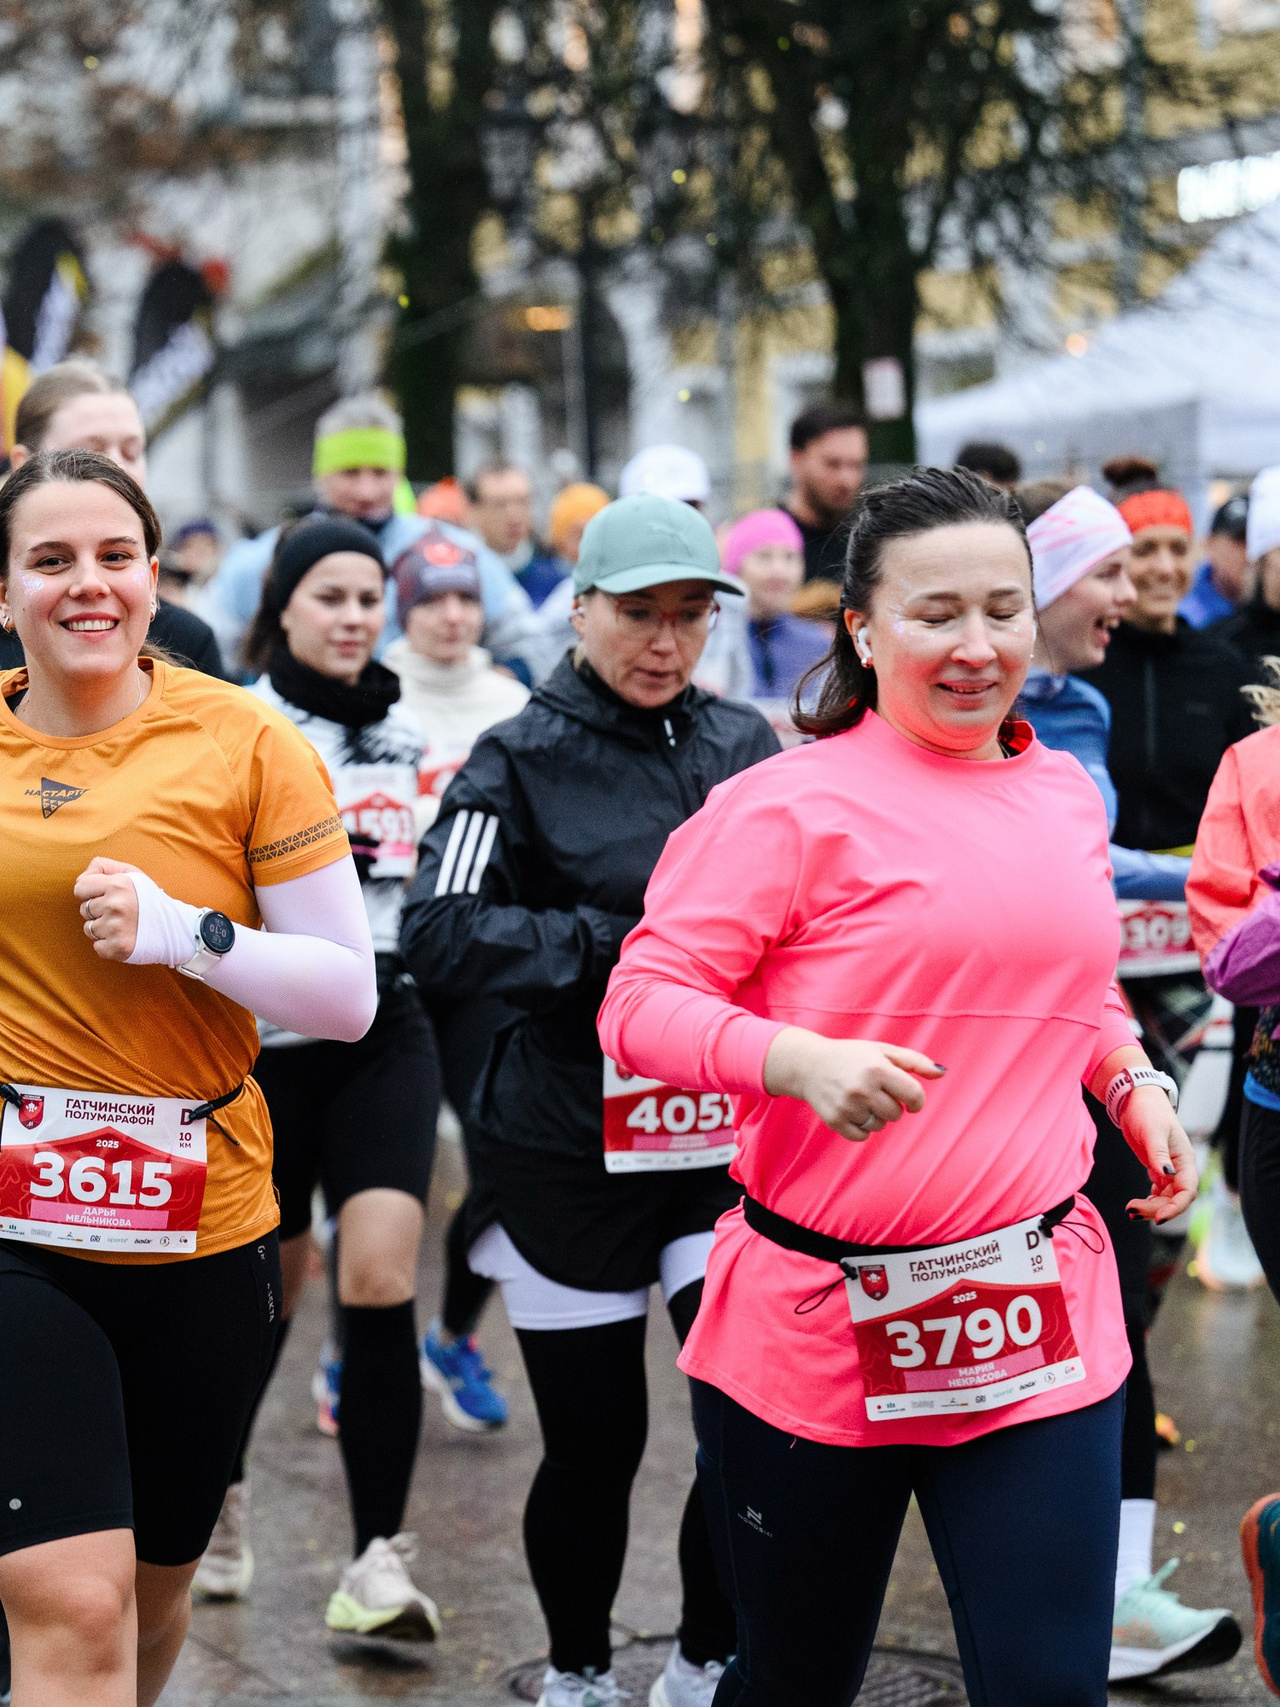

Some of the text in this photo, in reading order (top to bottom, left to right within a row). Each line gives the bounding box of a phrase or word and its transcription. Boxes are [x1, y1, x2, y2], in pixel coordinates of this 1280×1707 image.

[66, 1098, 155, 1116] ГАТЧИНСКИЙ
[65, 1109, 154, 1125] ПОЛУМАРАФОН
[180, 1108, 195, 1125] D
[96, 1139, 119, 1148] 2025
[179, 1132, 192, 1141] 10
[29, 1152, 172, 1207] 3615
[83, 1206, 116, 1217] ДАРЬЯ
[65, 1214, 132, 1227] МЕЛЬНИКОВА
[1025, 1230, 1040, 1250] D
[909, 1240, 1000, 1272] ГАТЧИНСКИЙ
[1030, 1254, 1043, 1266] 10
[911, 1254, 1002, 1282] ПОЛУМАРАФОН
[952, 1291, 977, 1304] 2025
[885, 1295, 1042, 1368] 3790
[958, 1362, 995, 1377] МАРИЯ
[948, 1369, 1008, 1387] НЕКРАСОВА
